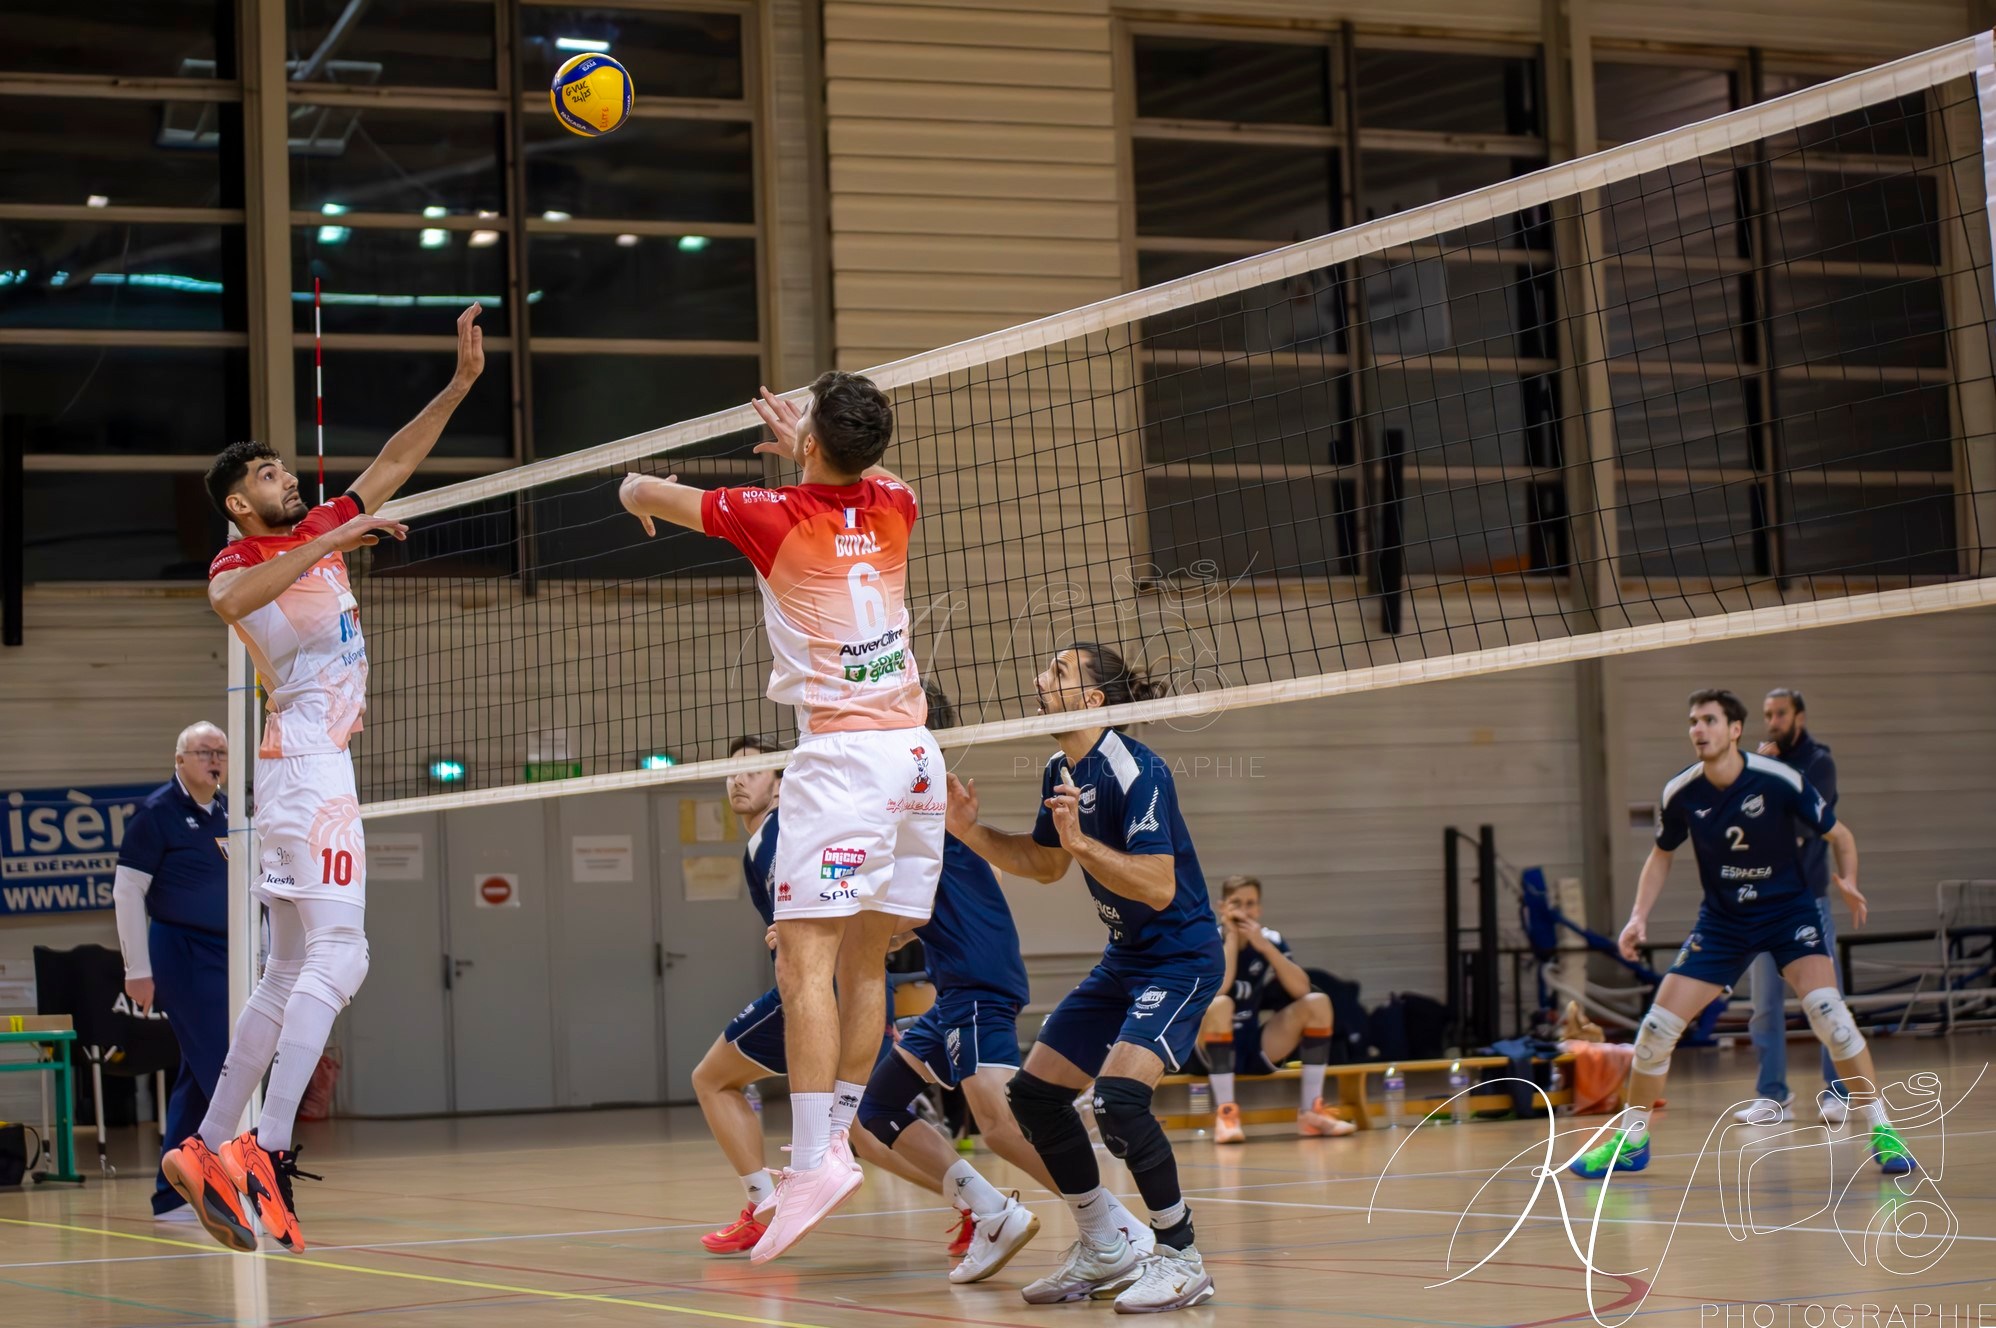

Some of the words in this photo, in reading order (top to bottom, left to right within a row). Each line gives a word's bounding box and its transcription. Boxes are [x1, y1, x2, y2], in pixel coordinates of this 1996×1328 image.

[742, 490, 770, 498] LYON
[835, 531, 881, 557] DUVAL
[847, 562, 885, 640] 6
[1725, 826, 1749, 850] 2
[5, 861, 29, 873] LE
[321, 848, 353, 886] 10
[820, 889, 859, 901] SPIE
